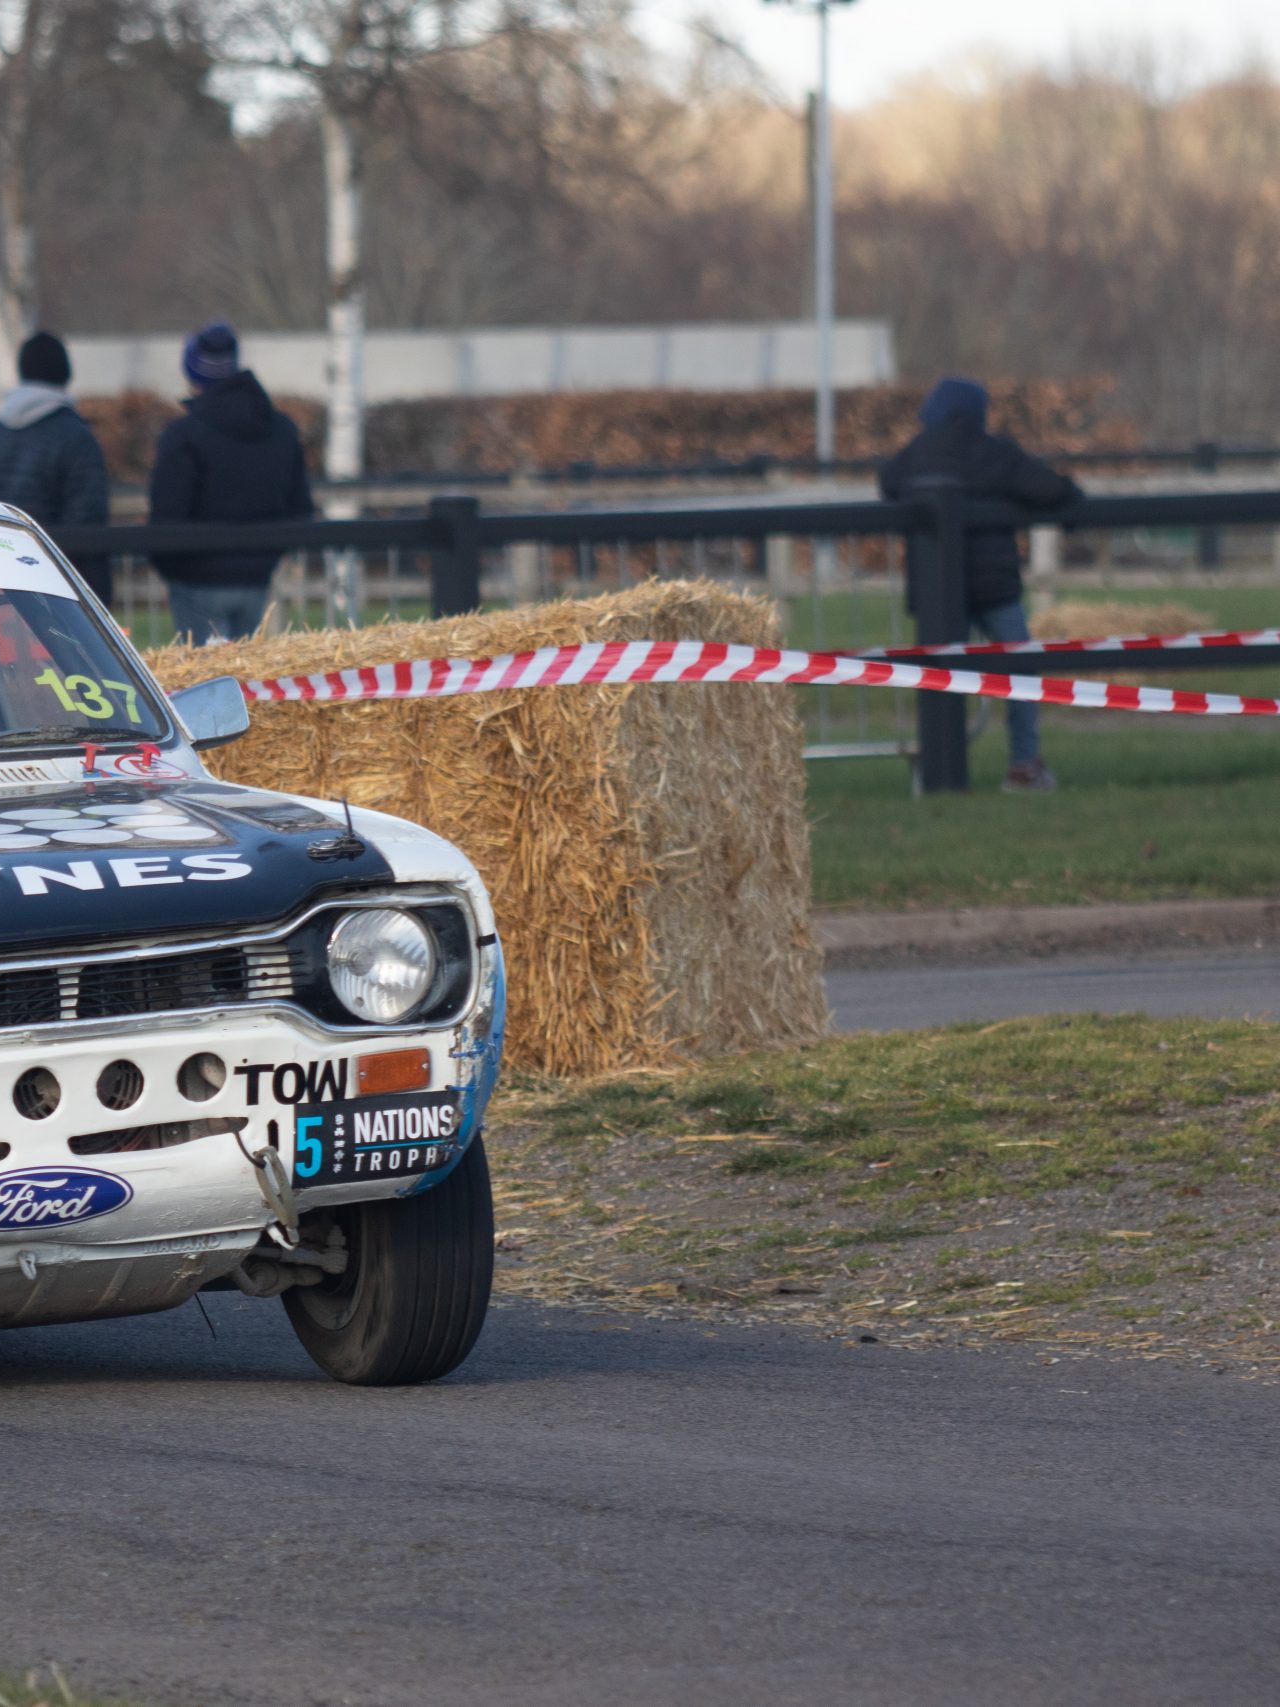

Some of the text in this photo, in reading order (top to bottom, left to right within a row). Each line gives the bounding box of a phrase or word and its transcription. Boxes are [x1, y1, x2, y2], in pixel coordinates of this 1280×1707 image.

[33, 668, 143, 733] 137
[234, 1057, 349, 1106] TOW
[295, 1104, 455, 1179] 5 NATIONS
